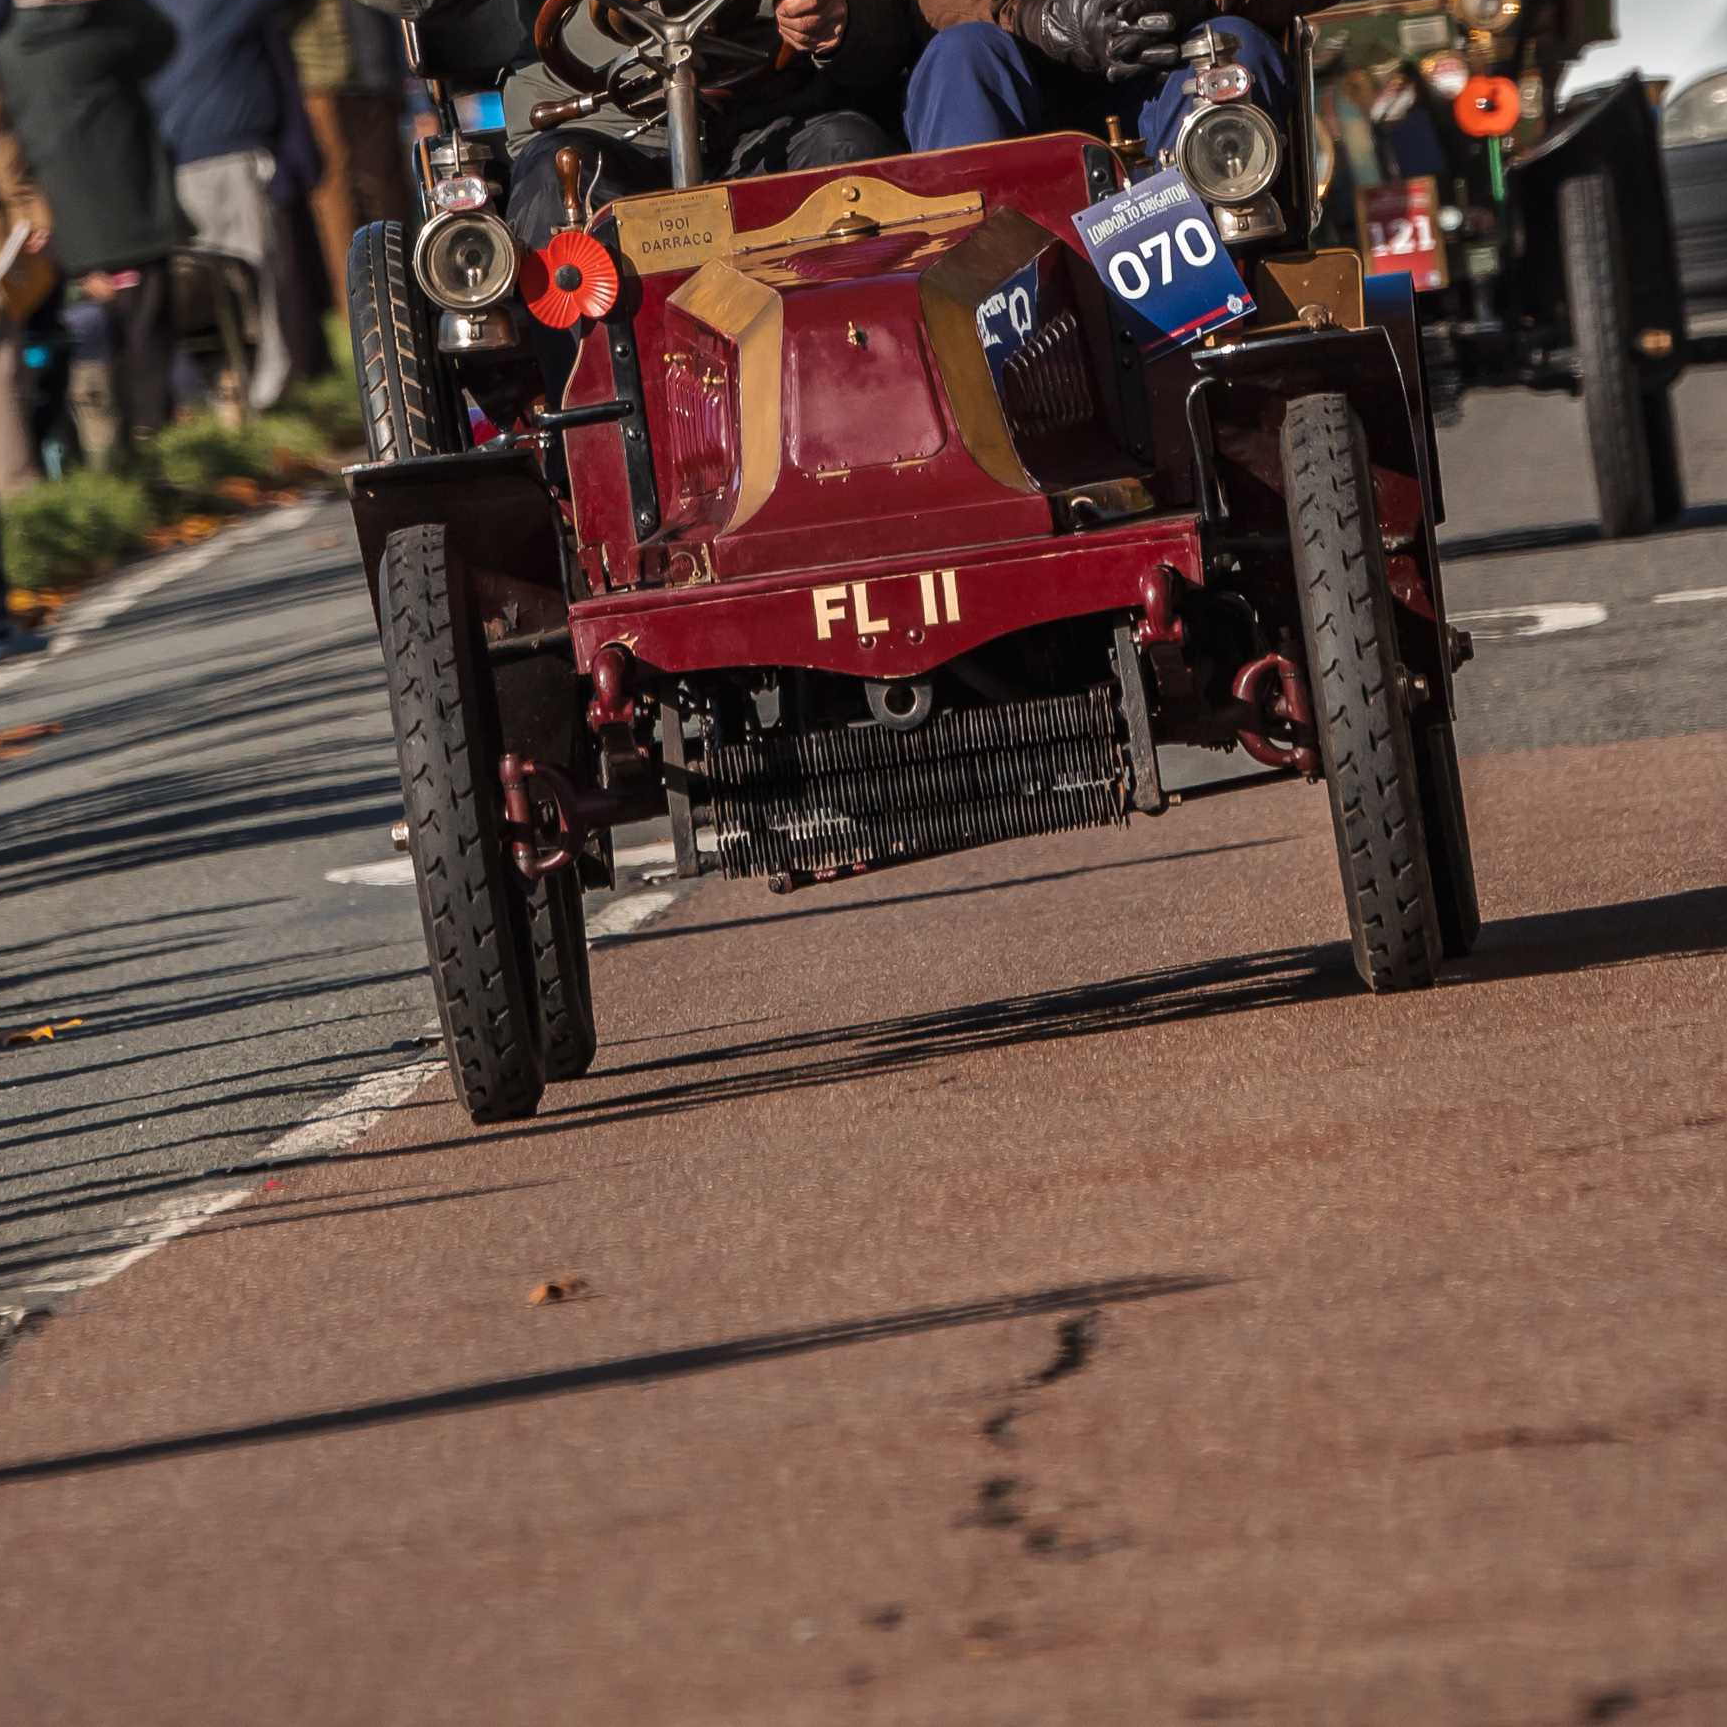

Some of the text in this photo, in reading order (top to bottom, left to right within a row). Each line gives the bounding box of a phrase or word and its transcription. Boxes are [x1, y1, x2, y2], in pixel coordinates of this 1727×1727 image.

[660, 217, 689, 231] 1901
[1087, 181, 1190, 246] LONDON TO BRIGHTON
[1369, 215, 1436, 257] 121
[642, 231, 712, 253] DARRACQ
[1108, 218, 1216, 299] 070
[812, 582, 890, 640] FL
